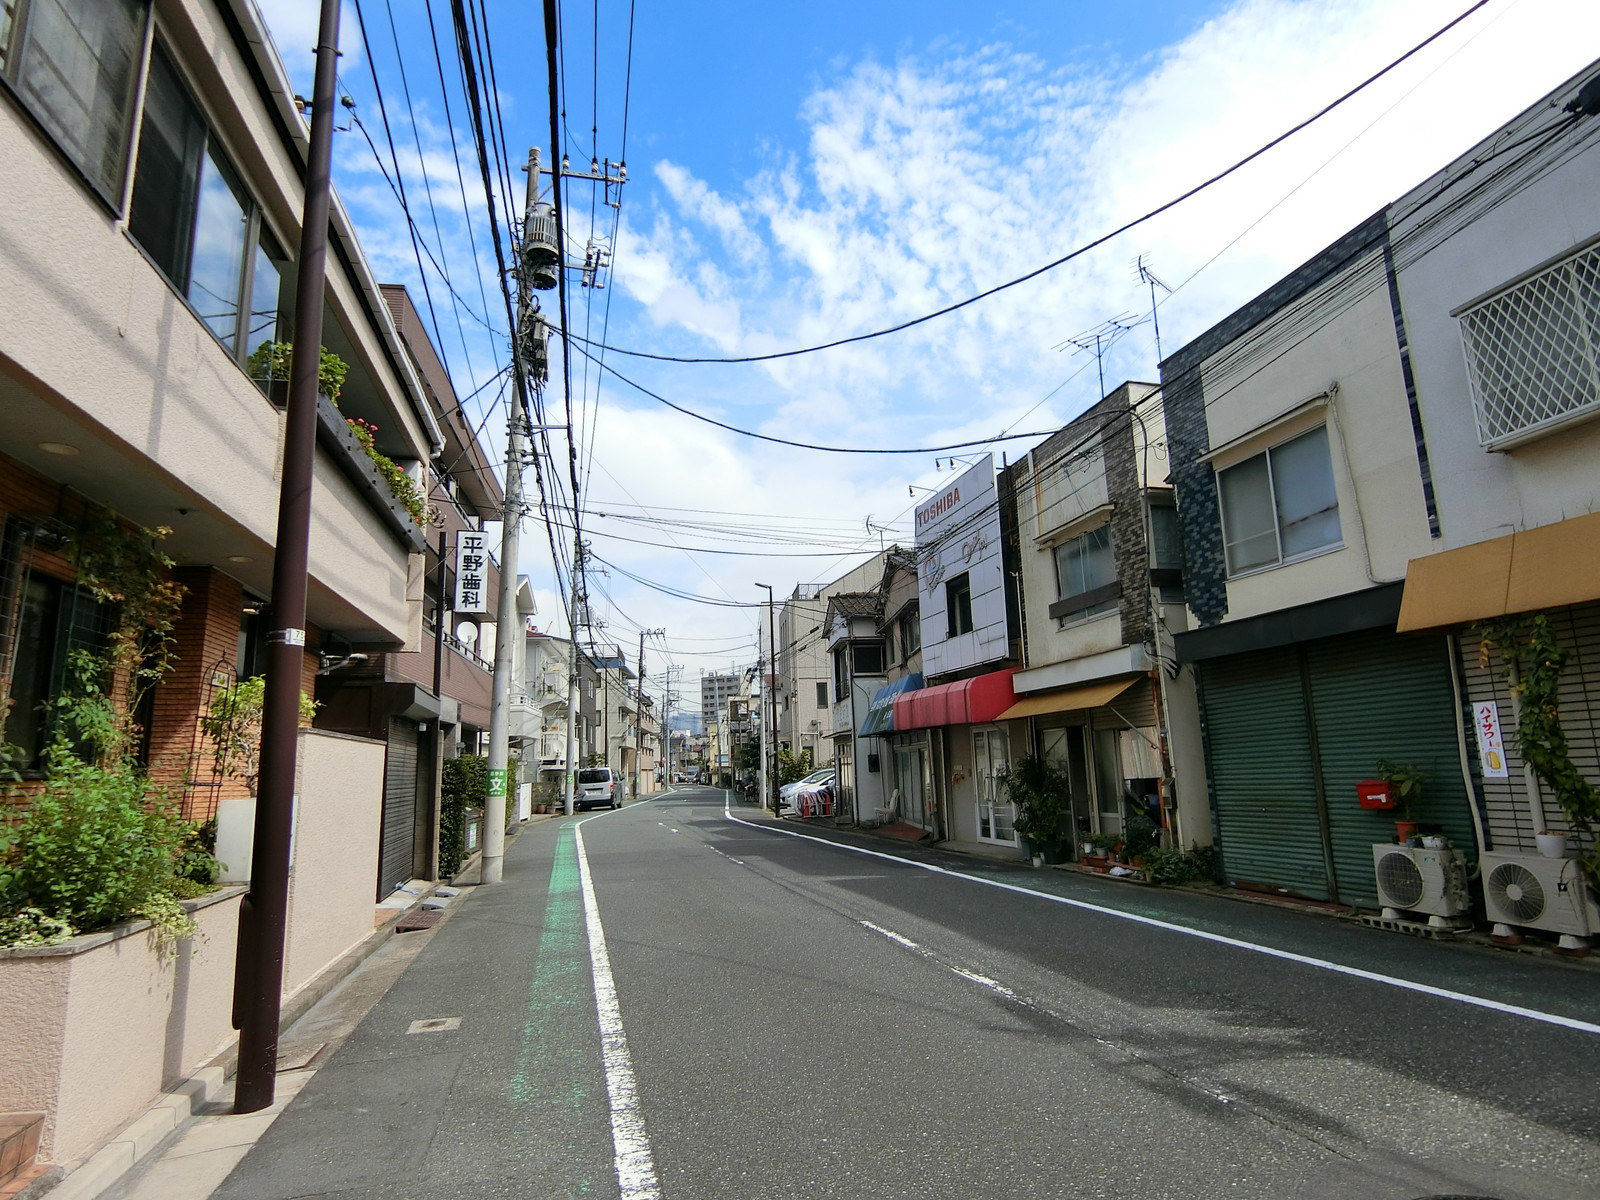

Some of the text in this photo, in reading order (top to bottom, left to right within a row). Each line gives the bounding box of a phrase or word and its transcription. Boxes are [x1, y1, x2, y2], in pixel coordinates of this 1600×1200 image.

[917, 487, 960, 528] TOSHIBA
[462, 536, 483, 609] 平野歯科
[1480, 706, 1495, 747] ハイサワー
[489, 777, 504, 792] 文
